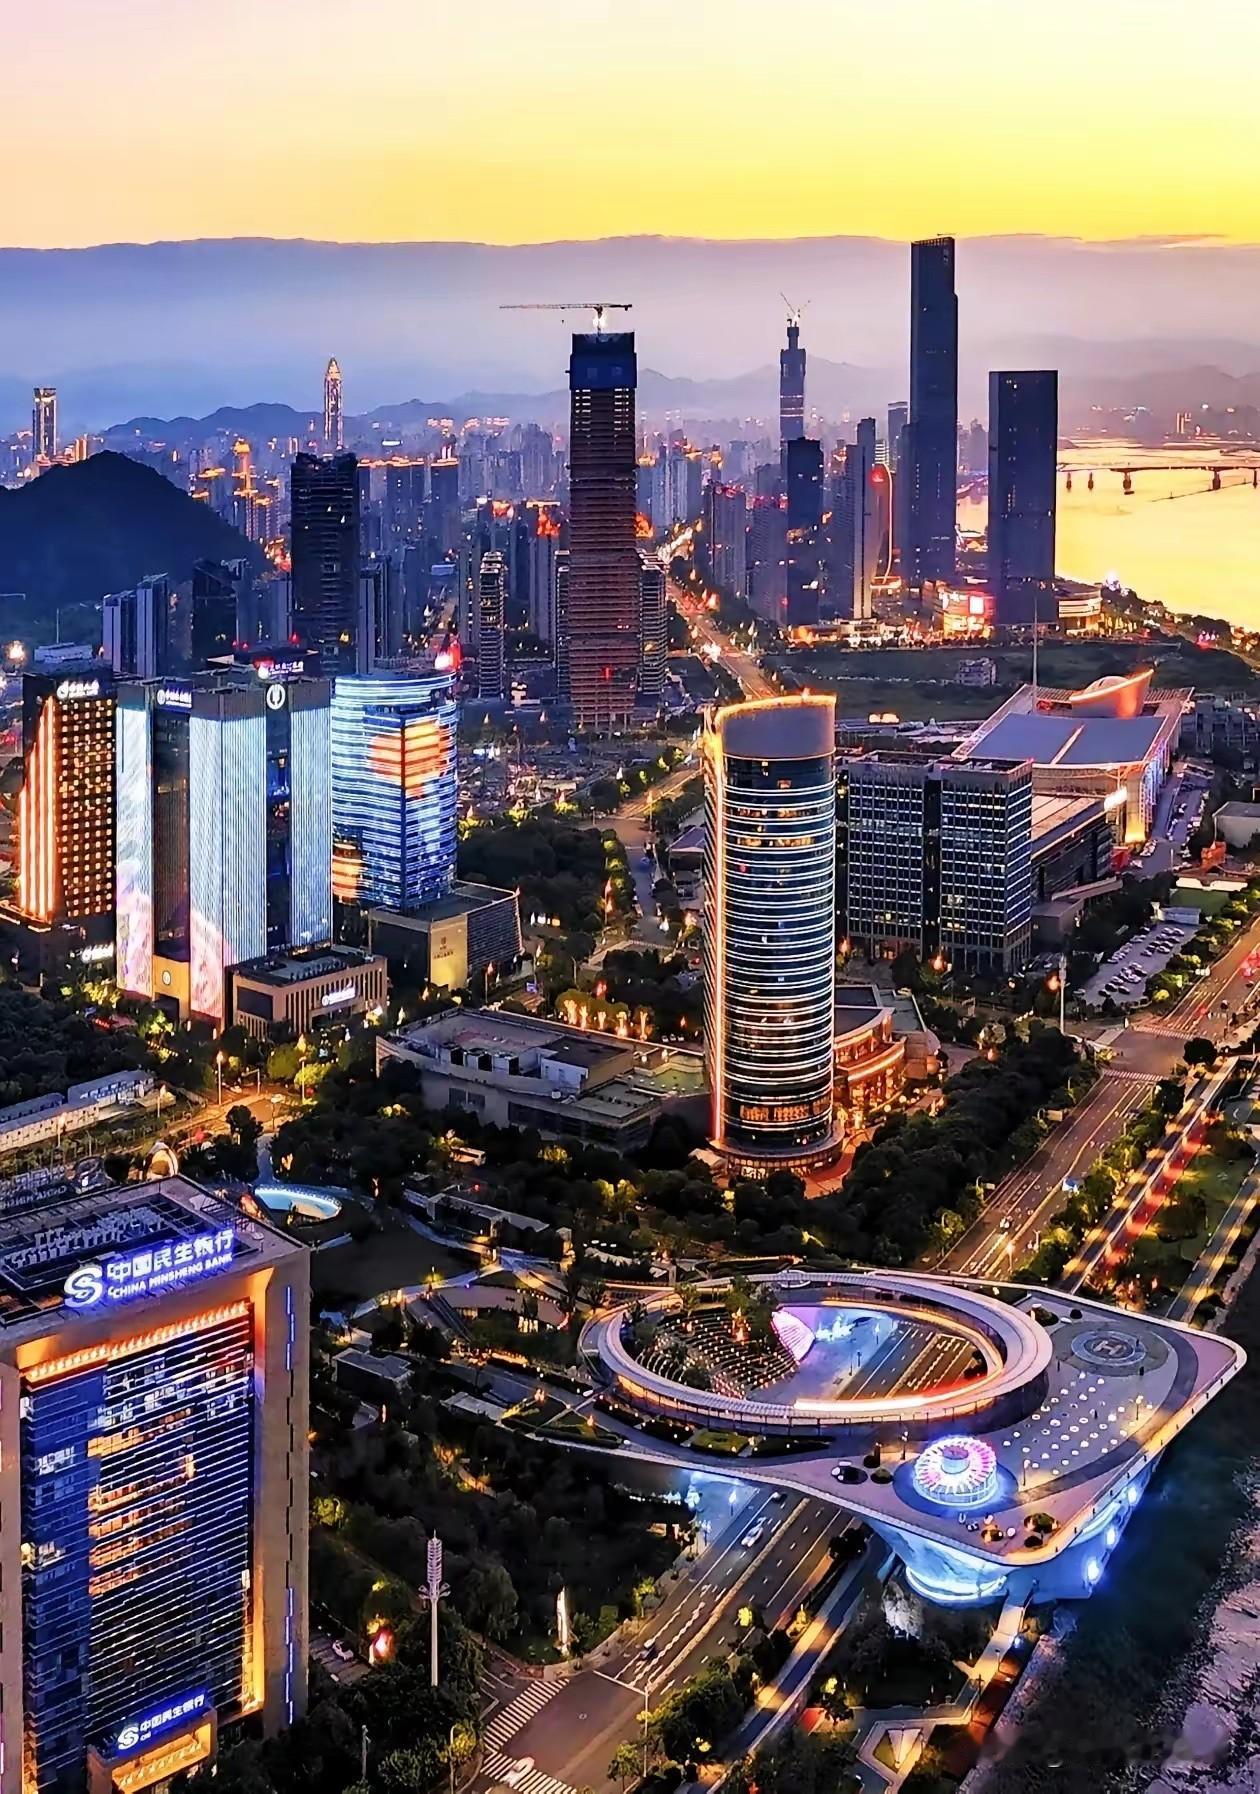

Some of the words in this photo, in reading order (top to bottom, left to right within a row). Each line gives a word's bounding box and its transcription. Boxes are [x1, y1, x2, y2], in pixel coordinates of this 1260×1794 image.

[107, 1229, 234, 1283] 中国民生银行
[108, 1281, 147, 1299] CHINA
[149, 1261, 203, 1288] MINSHENG
[205, 1252, 233, 1270] BANK
